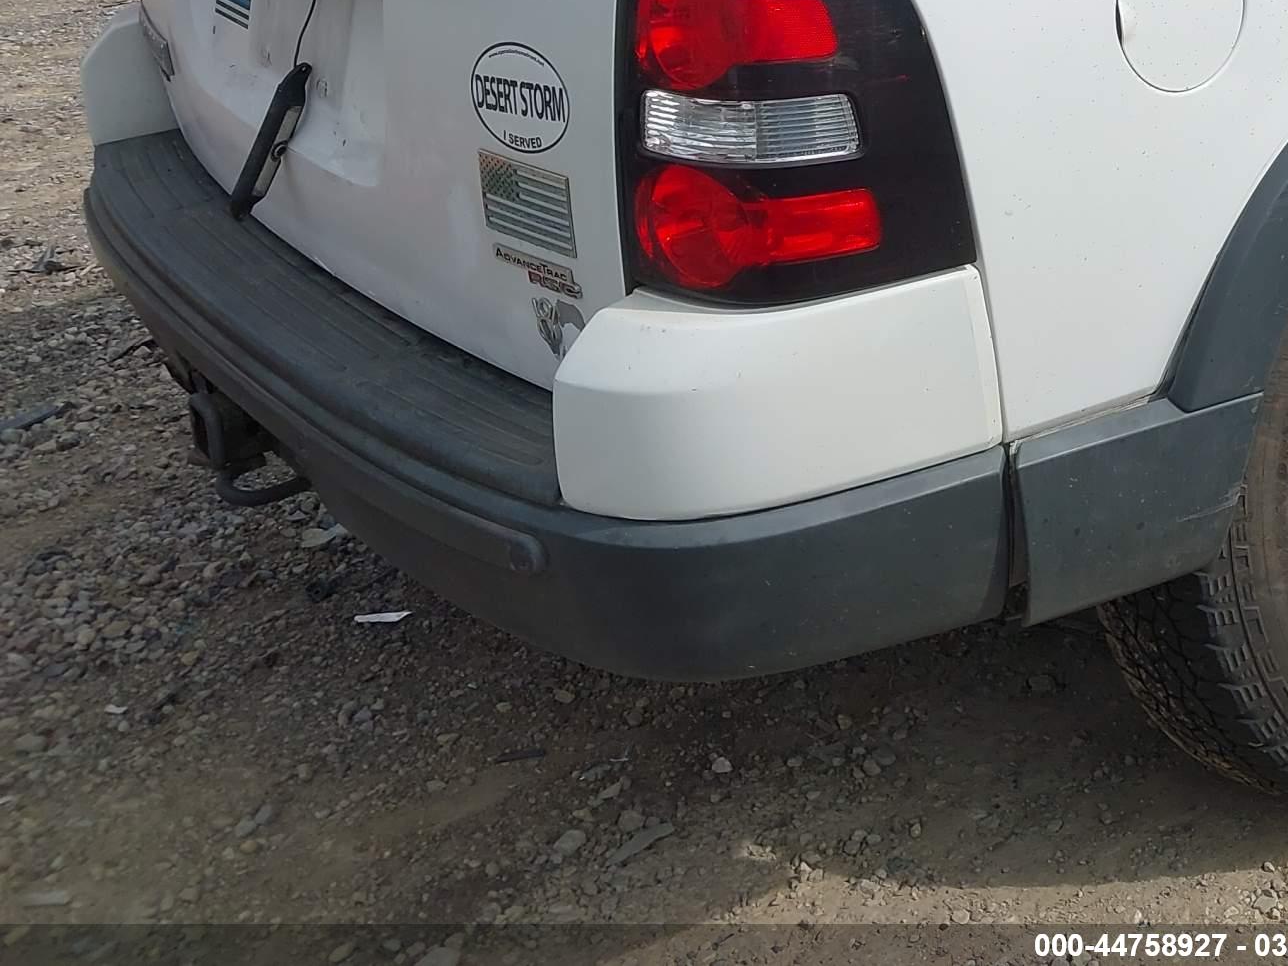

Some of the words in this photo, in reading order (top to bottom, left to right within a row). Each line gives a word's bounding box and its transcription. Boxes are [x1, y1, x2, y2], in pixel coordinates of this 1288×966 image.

[475, 73, 518, 115] DESERT
[519, 81, 566, 123] STORM
[503, 129, 507, 141] I
[508, 133, 542, 150] SERVED
